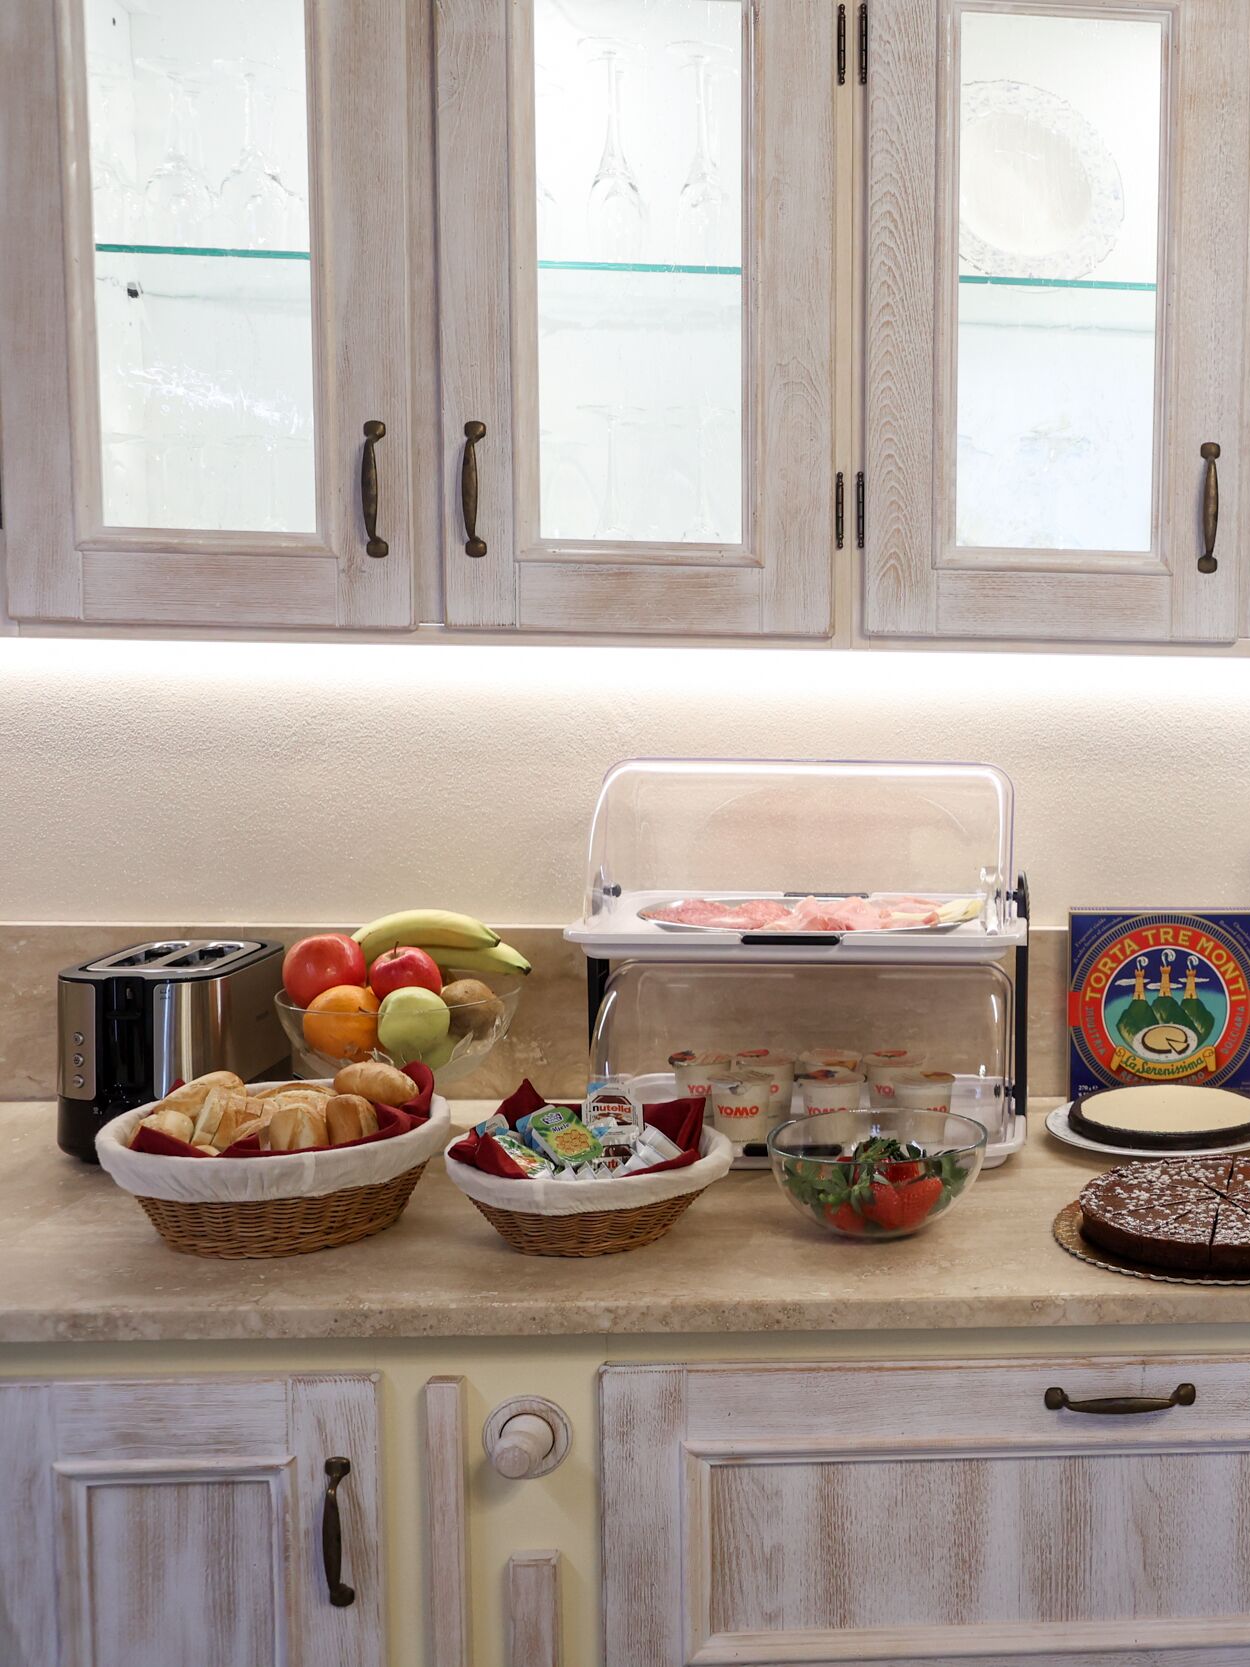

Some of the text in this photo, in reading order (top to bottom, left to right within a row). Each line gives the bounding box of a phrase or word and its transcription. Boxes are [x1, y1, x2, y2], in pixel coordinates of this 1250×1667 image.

[1085, 937, 1140, 1002] TORTA
[1142, 927, 1193, 946] TRE
[1195, 936, 1247, 1001] MONTI
[1221, 1006, 1246, 1055] DOLCIARIA
[1123, 1055, 1137, 1071] La
[1135, 1055, 1204, 1076] Serenissima
[687, 1084, 712, 1094] YO
[875, 1084, 895, 1097] YO
[592, 1104, 632, 1114] nutella
[716, 1104, 760, 1116] YOMO
[807, 1106, 847, 1116] YO
